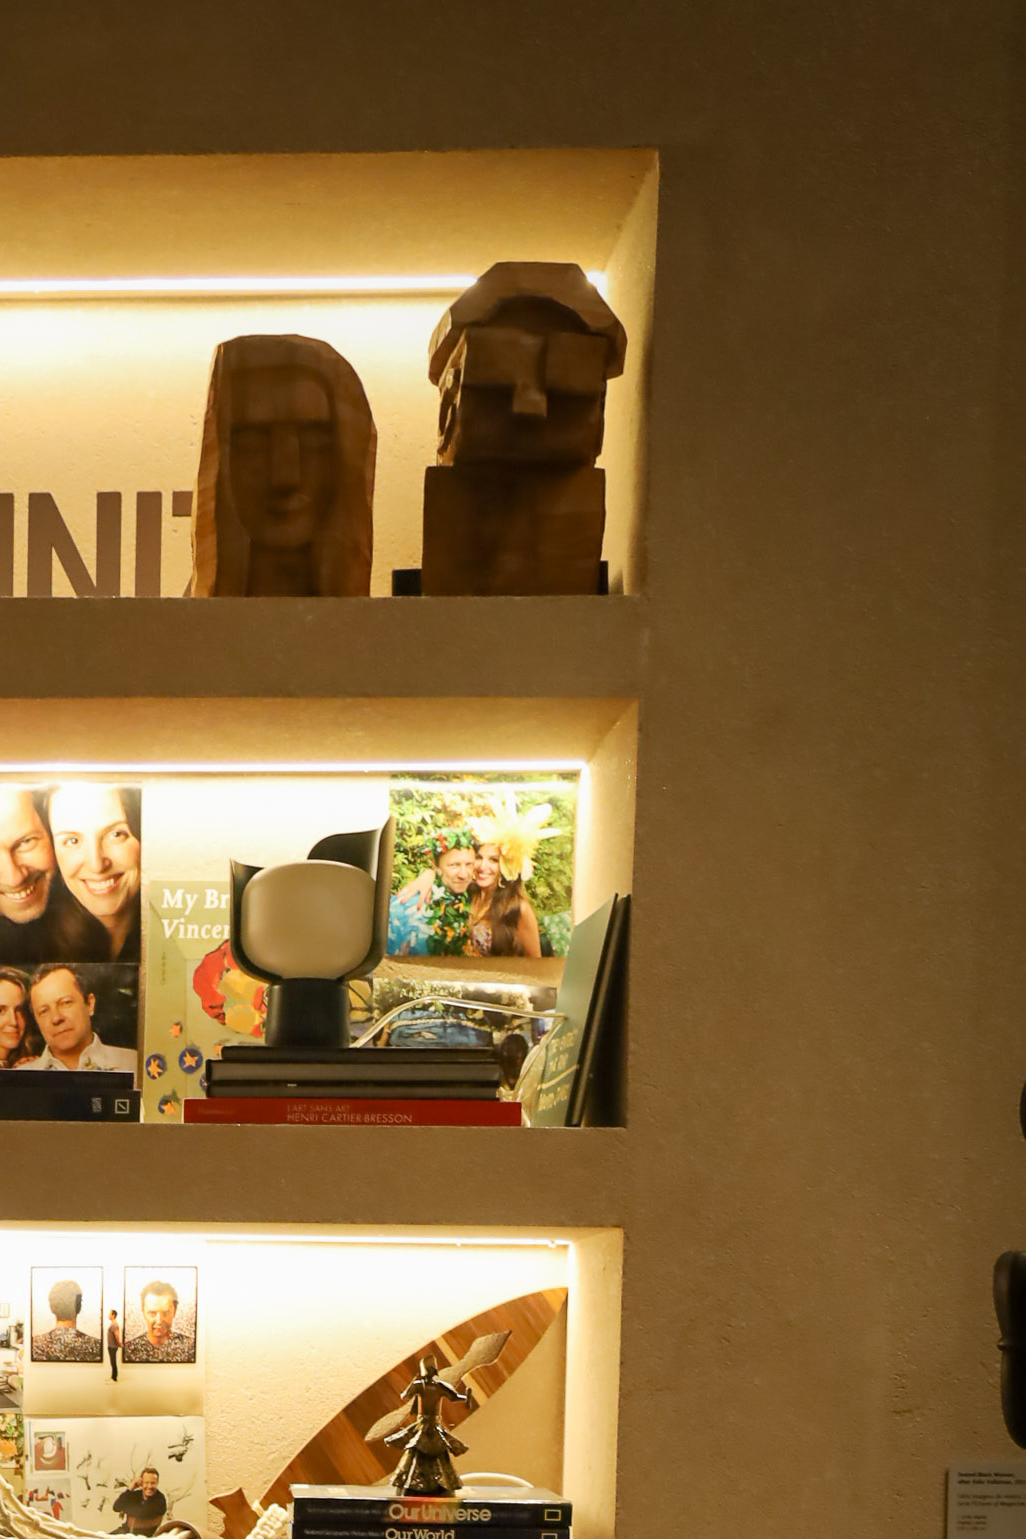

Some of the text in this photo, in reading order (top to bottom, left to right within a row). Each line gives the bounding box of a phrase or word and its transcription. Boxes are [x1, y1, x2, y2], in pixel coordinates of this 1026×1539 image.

[161, 888, 231, 915] My Br
[309, 1104, 332, 1113] SANS
[335, 1105, 351, 1113] ART
[287, 1113, 413, 1124] HENRI CARTIER-BRESSON
